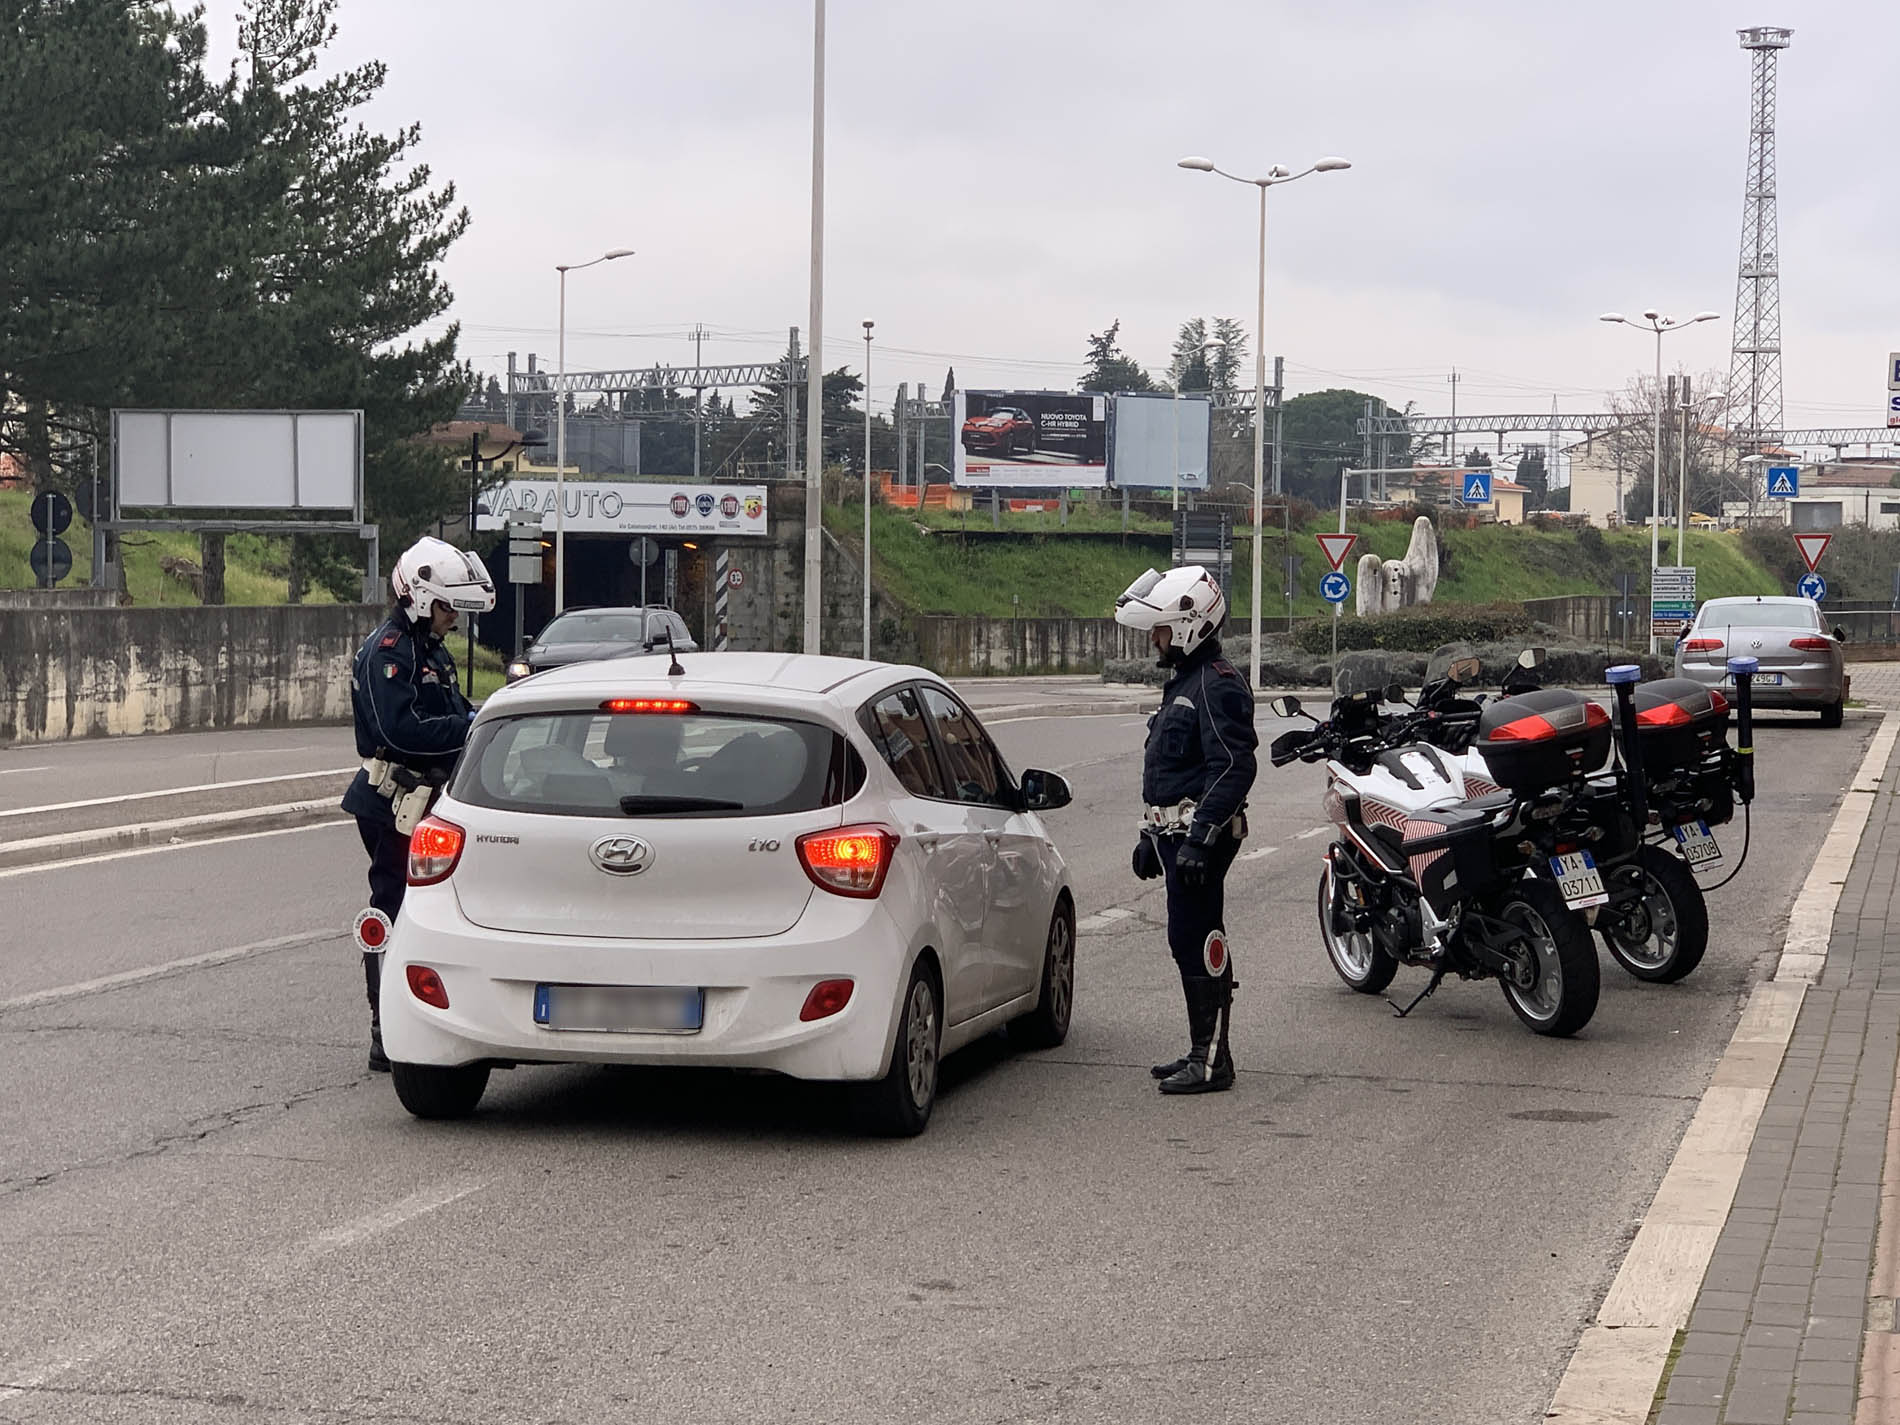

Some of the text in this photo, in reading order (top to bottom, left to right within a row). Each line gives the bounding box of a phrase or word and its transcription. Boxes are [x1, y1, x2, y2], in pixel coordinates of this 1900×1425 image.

[476, 834, 519, 845] HYUNDAI
[748, 837, 781, 852] i10
[1687, 841, 1717, 860] 03708
[1562, 876, 1601, 896] 03711
